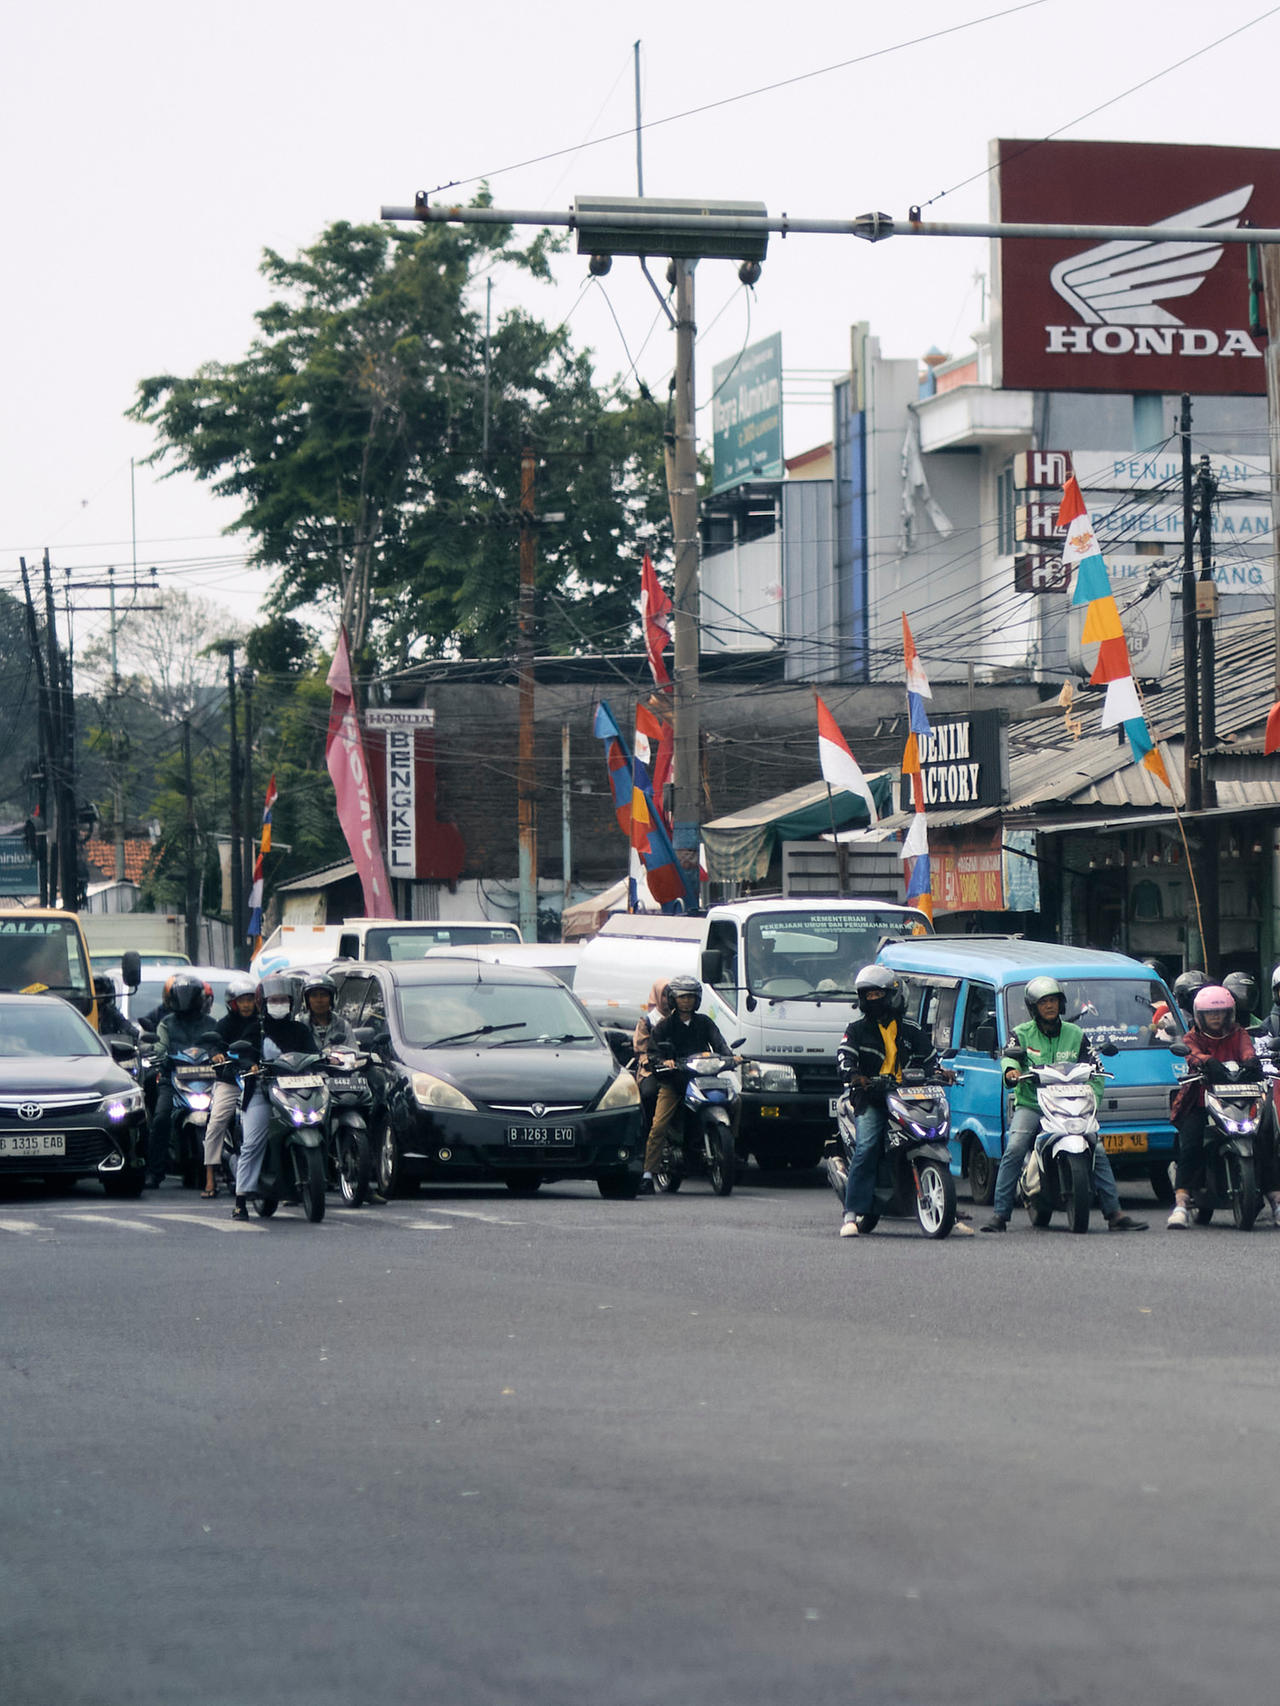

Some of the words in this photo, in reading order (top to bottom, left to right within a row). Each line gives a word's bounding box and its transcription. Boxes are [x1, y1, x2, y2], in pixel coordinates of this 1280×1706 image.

[1045, 326, 1263, 357] HONDA
[1113, 461, 1248, 482] PENJUAN
[1091, 512, 1269, 533] PEMELIHRAAN
[369, 713, 431, 724] HONDA
[918, 721, 970, 764] DENIM
[390, 731, 411, 867] BENGKEL
[12, 1138, 39, 1150] 1315
[44, 1137, 63, 1148] EAB
[511, 1128, 517, 1140] B
[524, 1128, 547, 1140] 1263
